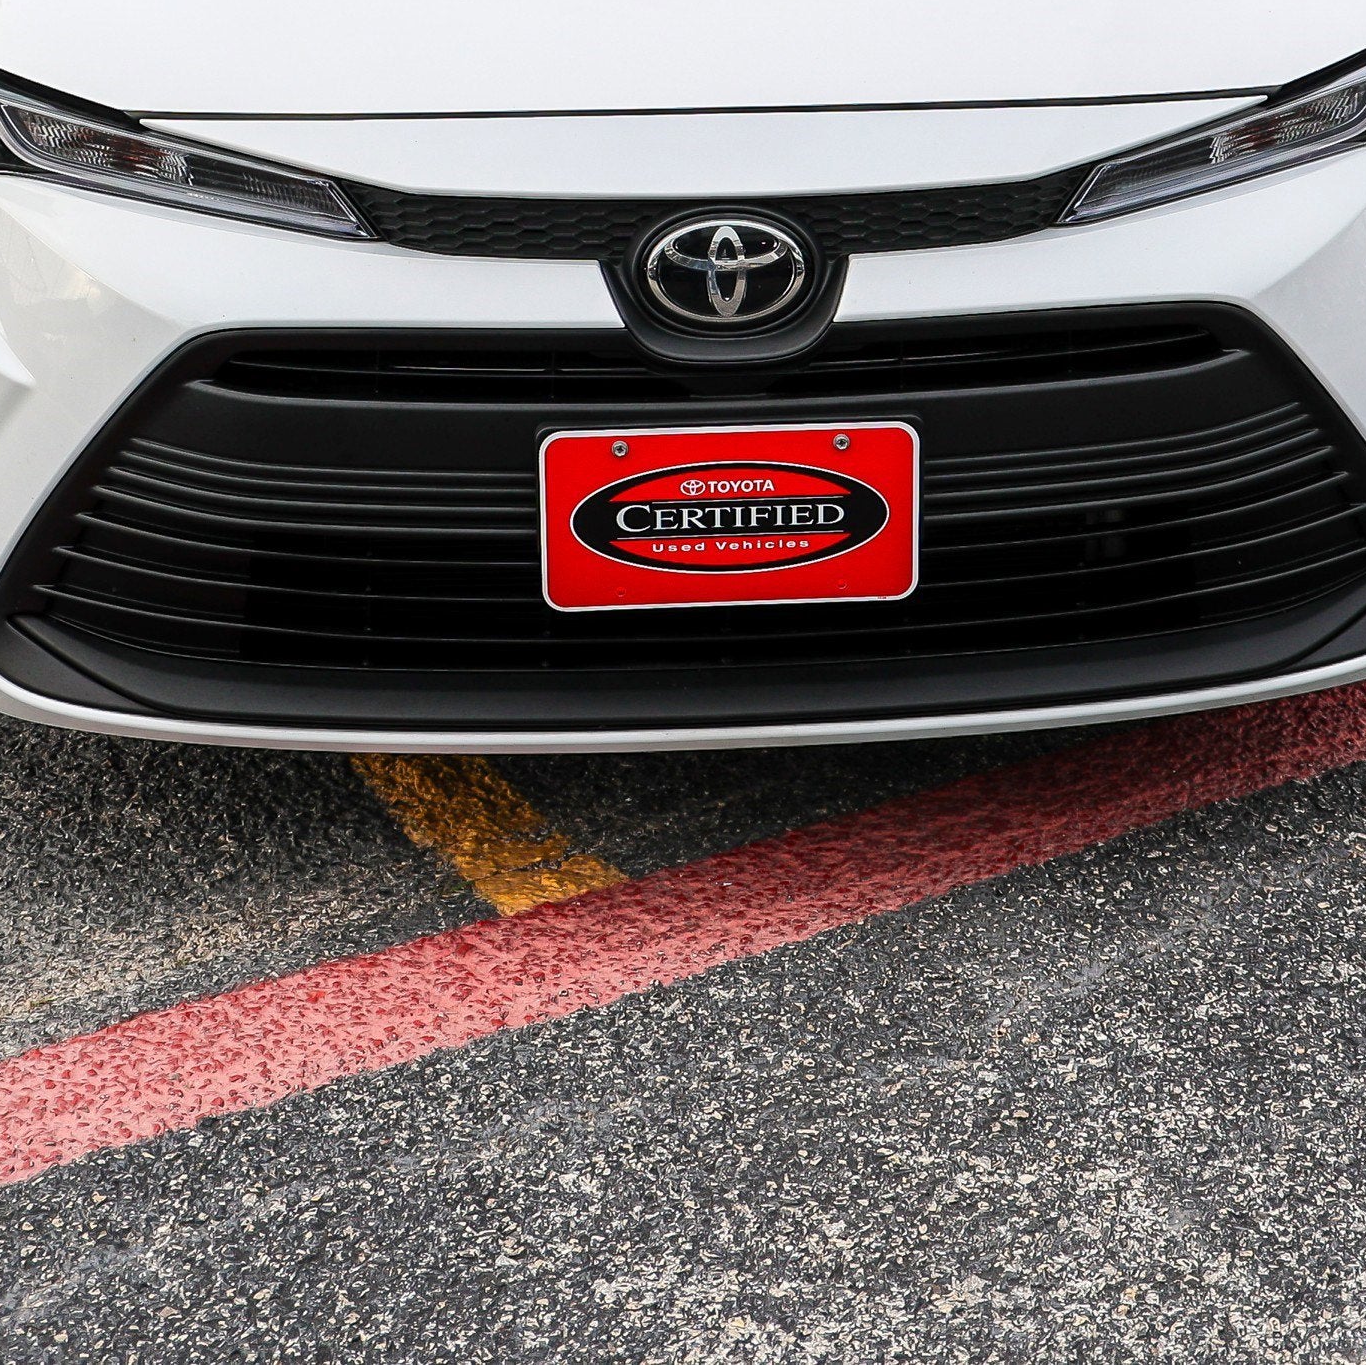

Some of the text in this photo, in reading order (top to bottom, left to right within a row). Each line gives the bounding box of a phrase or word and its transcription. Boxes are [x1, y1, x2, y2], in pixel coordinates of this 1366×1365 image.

[707, 479, 775, 494] TOYOTA
[615, 502, 846, 533] CERTIFIED
[652, 538, 810, 553] Used Vehicles
